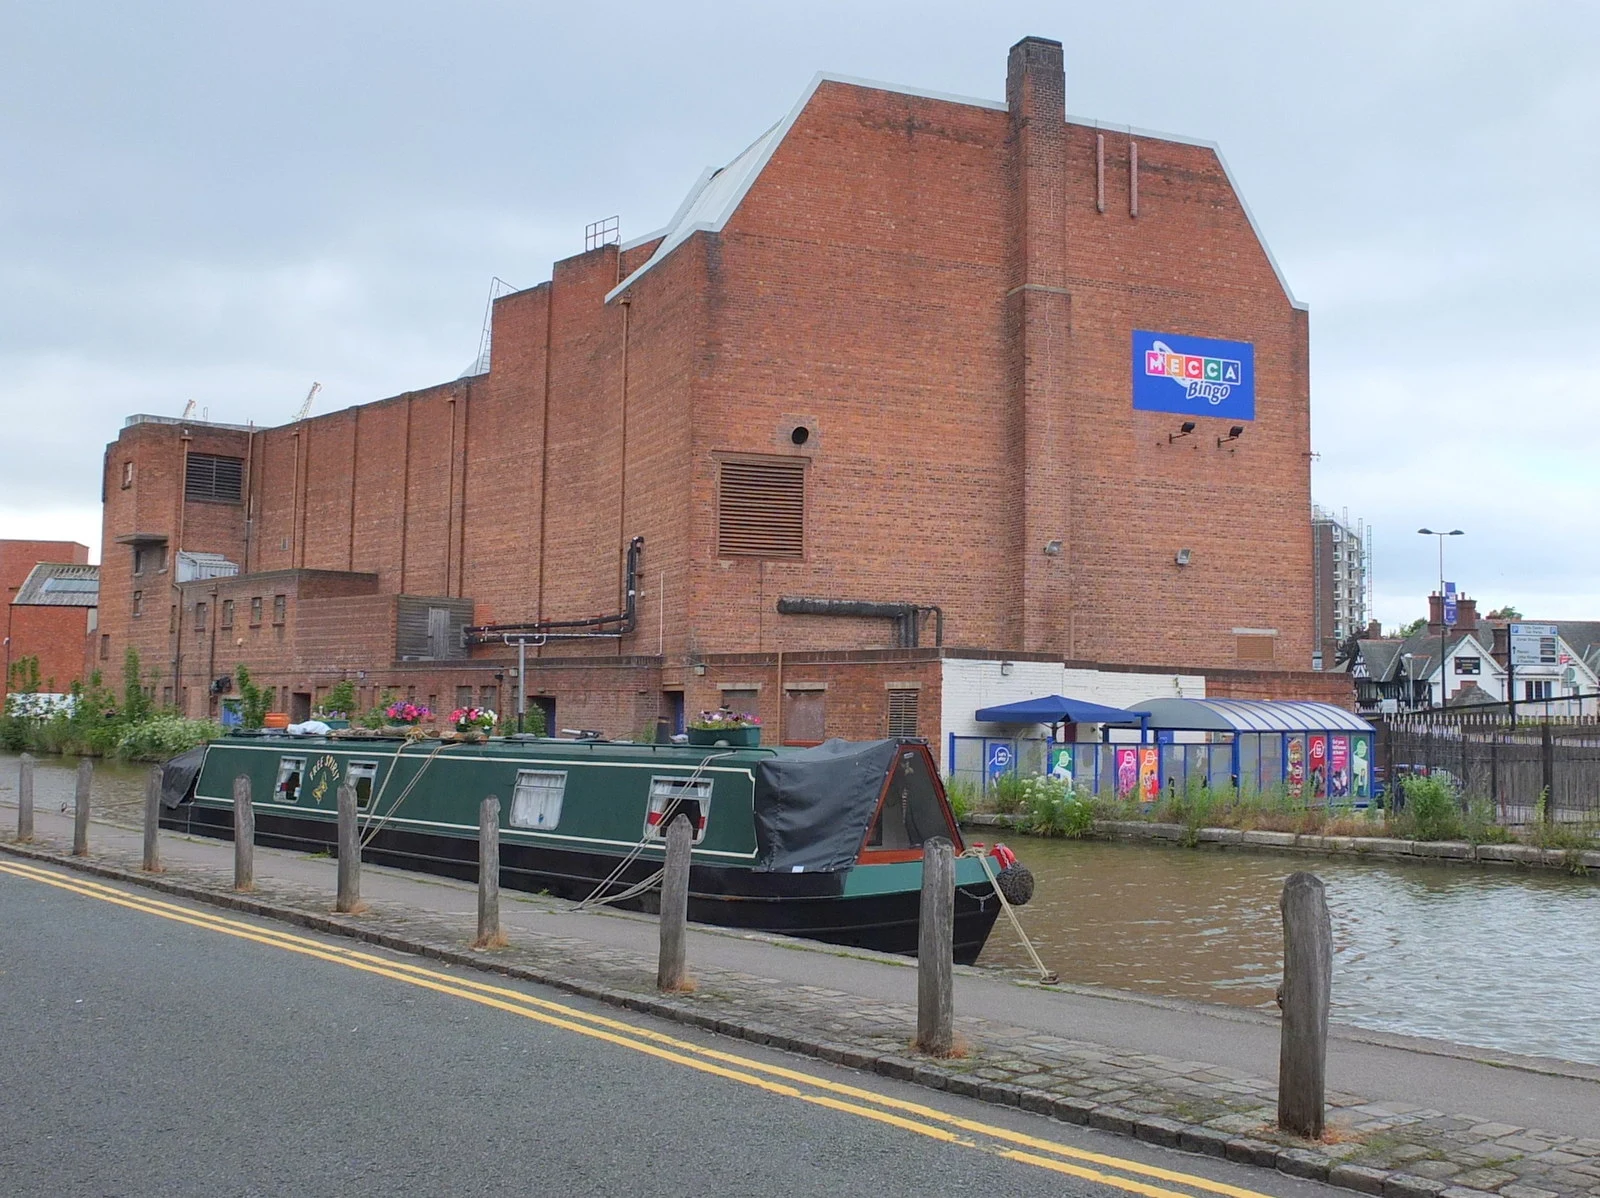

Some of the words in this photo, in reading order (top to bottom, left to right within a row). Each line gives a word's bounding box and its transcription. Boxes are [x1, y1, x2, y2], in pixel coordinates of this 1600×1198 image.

[1149, 354, 1238, 381] MECCA
[1187, 380, 1230, 403] Bingo
[309, 756, 324, 781] FREE
[325, 754, 340, 781] SPIRIT
